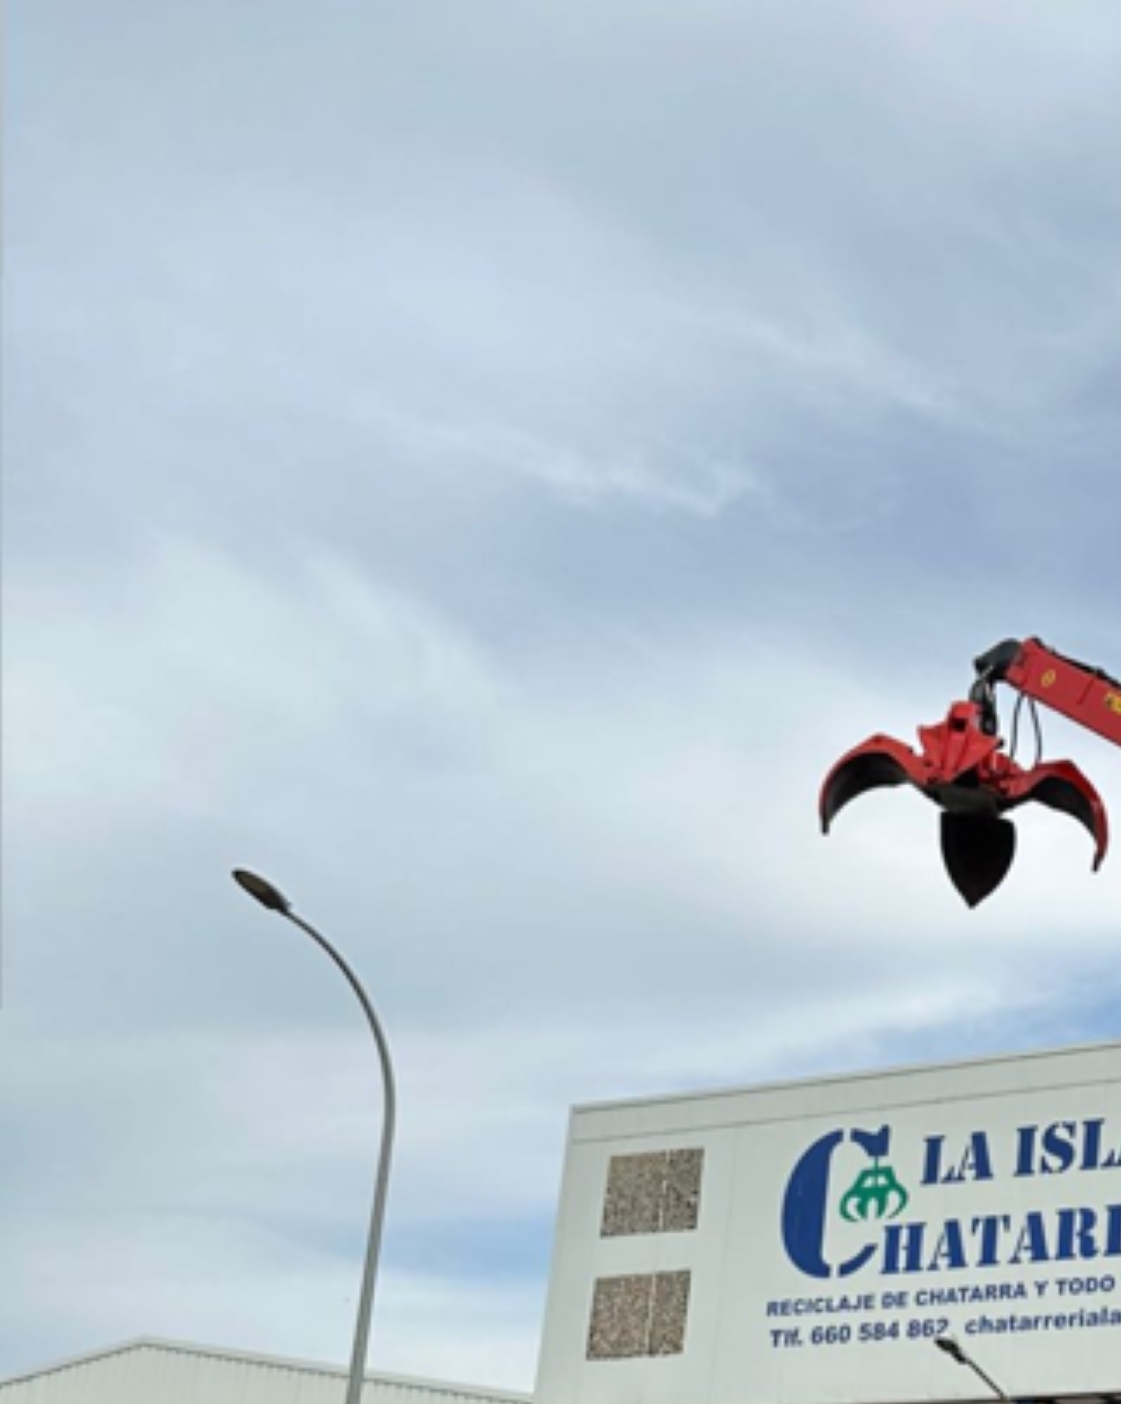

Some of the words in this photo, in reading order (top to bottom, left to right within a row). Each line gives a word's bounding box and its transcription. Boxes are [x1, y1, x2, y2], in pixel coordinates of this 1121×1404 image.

[919, 1131, 993, 1185] LA
[766, 1291, 875, 1317] RECICLAJE
[881, 1290, 908, 1309] DE
[915, 1282, 1027, 1307] CHATARRA
[1034, 1279, 1049, 1297] Y
[1055, 1274, 1116, 1296] TODO
[811, 1324, 852, 1345] 660
[858, 1321, 900, 1342] 584
